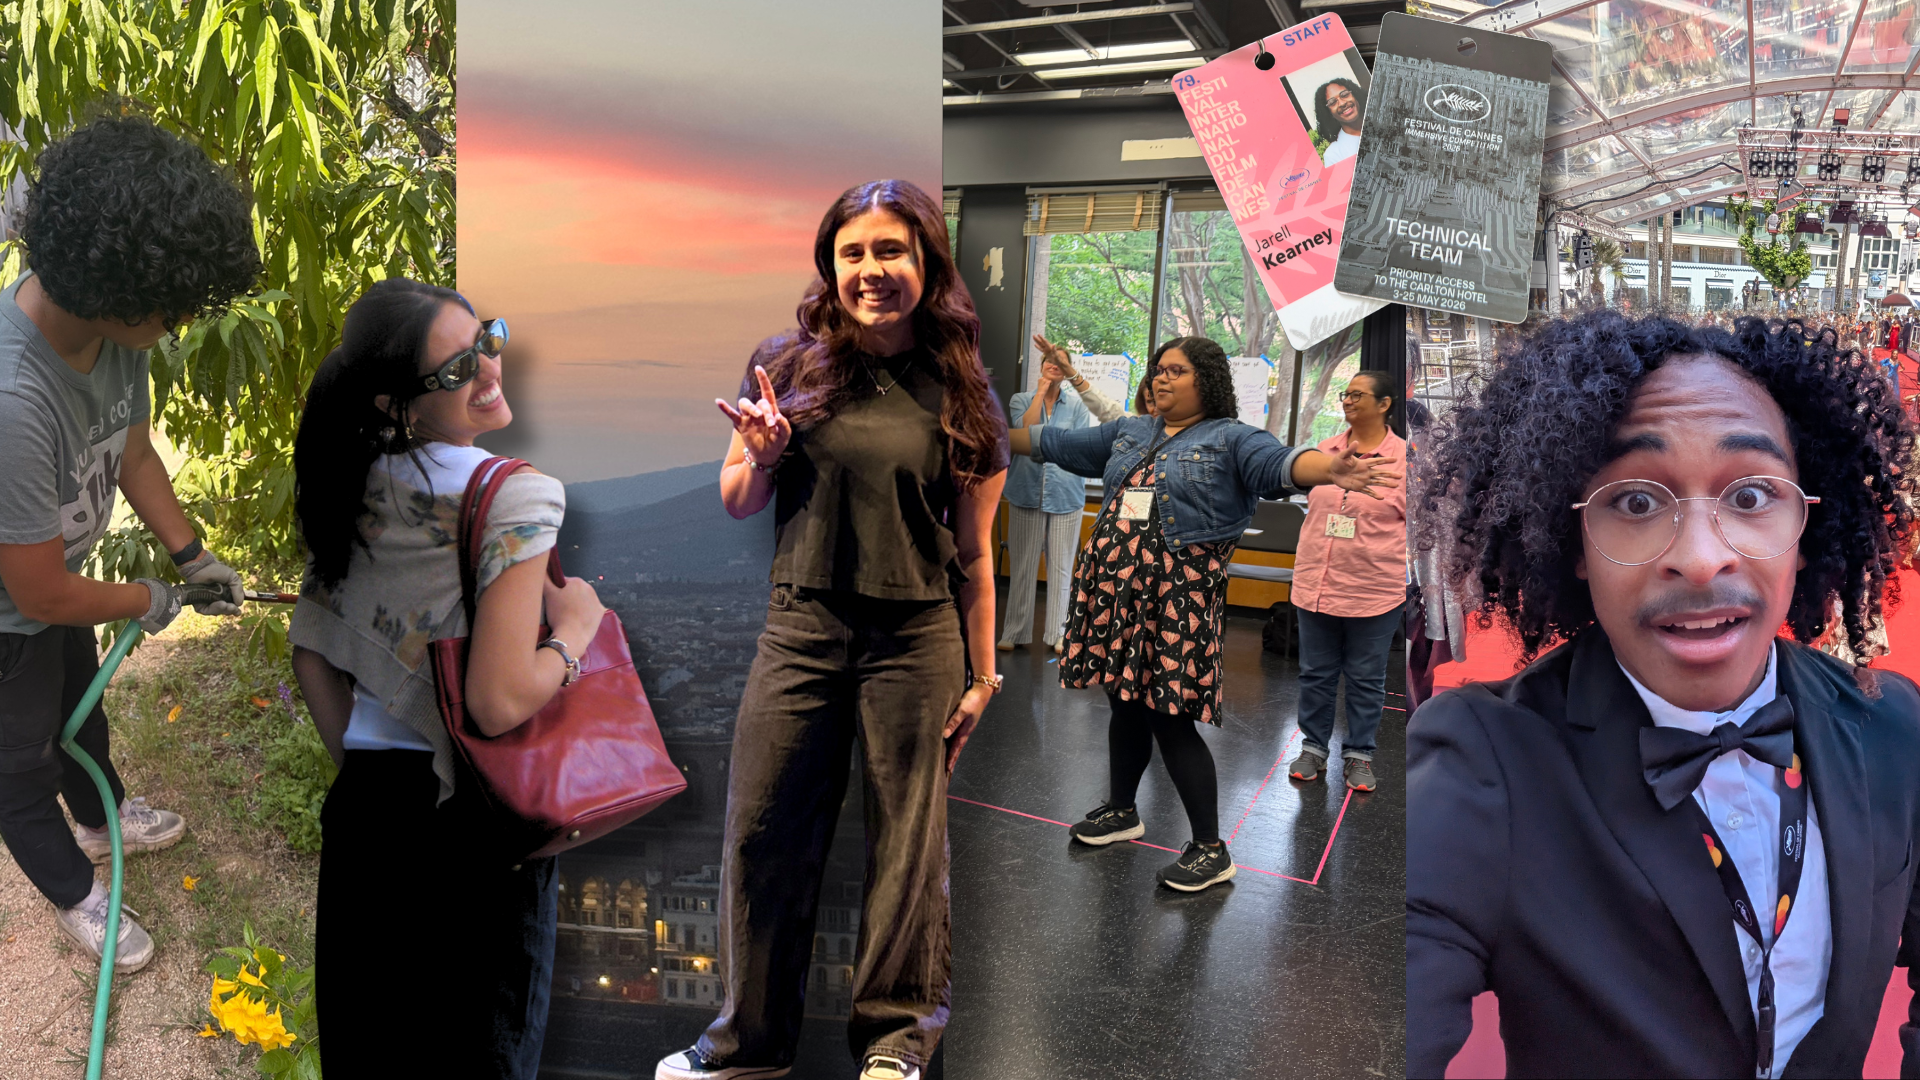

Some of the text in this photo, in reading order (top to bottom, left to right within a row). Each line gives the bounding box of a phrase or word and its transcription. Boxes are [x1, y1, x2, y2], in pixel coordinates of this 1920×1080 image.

[1283, 17, 1332, 46] STAFF
[1174, 74, 1200, 91] 79.
[1180, 76, 1228, 104] FESTI
[1186, 96, 1222, 115] VAL
[1191, 100, 1242, 130] INTER
[1197, 113, 1247, 142] NATIO
[1404, 117, 1503, 143] FESTIVAL DE CANNES
[1405, 128, 1500, 151] IMMERSIVE COMPETITION
[1203, 133, 1240, 155] NAL
[1442, 142, 1460, 152] 2026
[1209, 147, 1236, 168] DU
[1216, 154, 1257, 182] FILM
[1222, 173, 1248, 194] DE
[1229, 181, 1266, 207] CAN
[1234, 196, 1271, 221] NES
[1255, 224, 1291, 253] Jarell
[1386, 217, 1492, 251] TECHNICAL
[1262, 228, 1333, 270] Kearney
[1409, 240, 1463, 266] TEAM
[1389, 267, 1475, 290] PRIORITY ACCESS
[1626, 266, 1641, 274] Dior
[1374, 274, 1488, 304] TO THE CARLTON HOTEL
[1393, 289, 1466, 310] 3-25 MAY 2026
